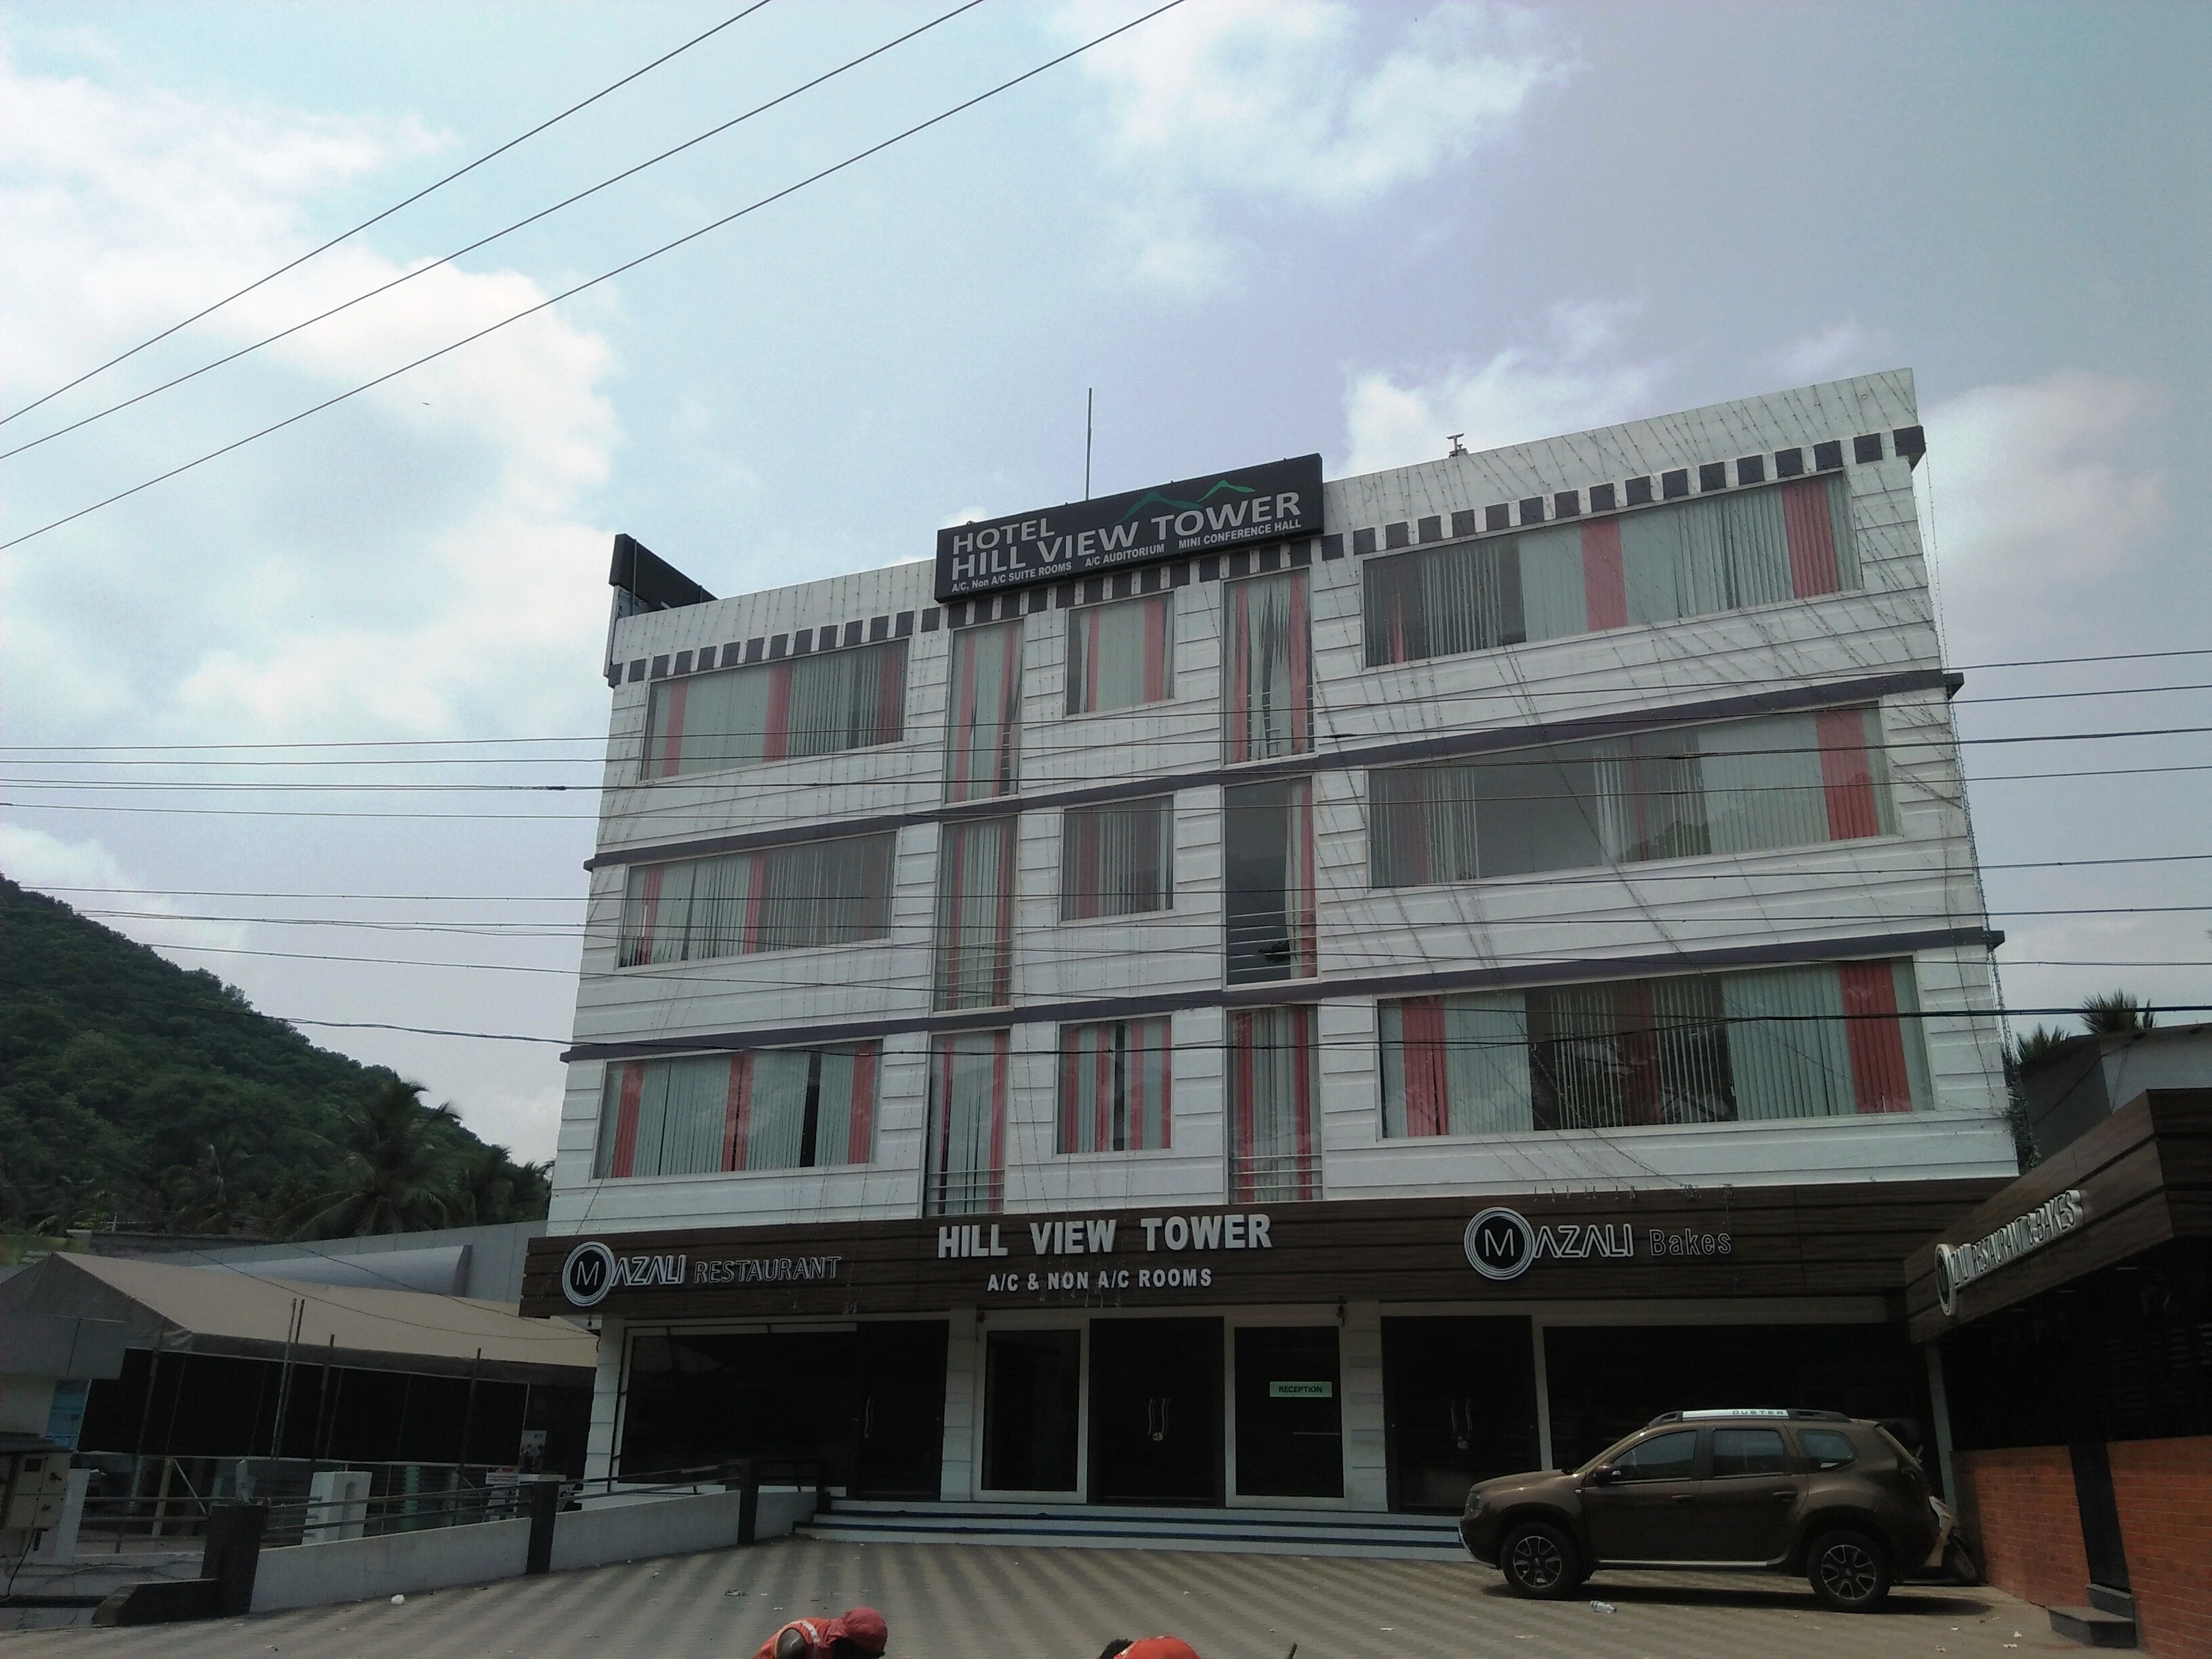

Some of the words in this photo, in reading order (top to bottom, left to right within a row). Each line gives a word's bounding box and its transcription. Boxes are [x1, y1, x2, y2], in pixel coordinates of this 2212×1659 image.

[951, 546, 1027, 581] HILL
[1037, 521, 1139, 563] VIEW
[1151, 491, 1301, 541] TOWER
[951, 581, 969, 592] A/C,
[972, 578, 989, 589] Non
[991, 574, 1006, 586] A/C
[1008, 568, 1036, 582] SUITE
[1038, 561, 1072, 577] ROOMS
[1085, 556, 1101, 567] A/C
[1103, 543, 1165, 564] AUDITORIUM
[1179, 536, 1201, 550] MINI
[1203, 523, 1271, 545] CONFERENCE
[1274, 518, 1301, 533] HALL
[953, 517, 1055, 555] HOTEL
[938, 1224, 1009, 1258] HILL
[1029, 1219, 1118, 1255] VIEW
[1140, 1214, 1273, 1252] TOWER
[2034, 1189, 2083, 1242] BAKES
[1650, 1228, 1732, 1256] Bakes
[694, 1256, 842, 1284] RESTAURANT
[987, 1273, 1019, 1292] A/C
[1027, 1273, 1040, 1290] &
[1048, 1271, 1090, 1290] NON
[1097, 1270, 1130, 1289] A/C
[1139, 1268, 1212, 1288] ROOMS
